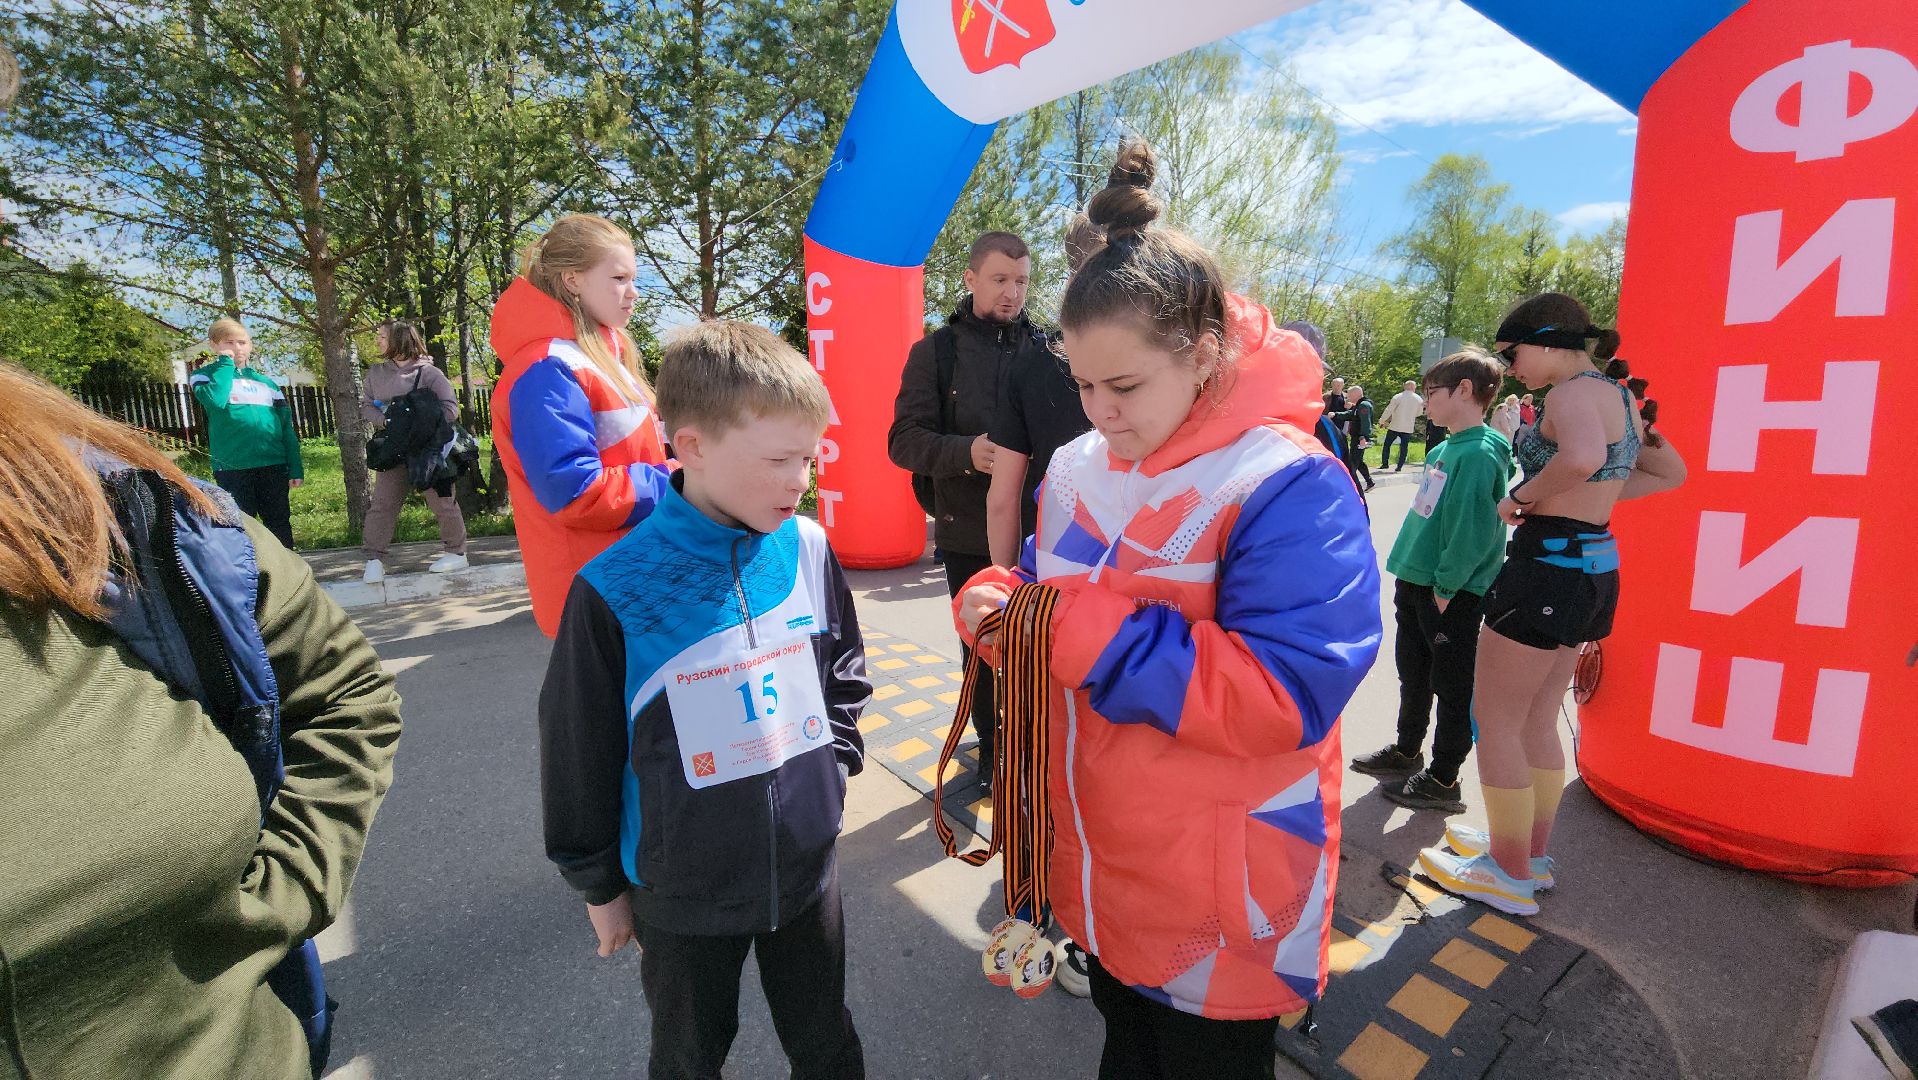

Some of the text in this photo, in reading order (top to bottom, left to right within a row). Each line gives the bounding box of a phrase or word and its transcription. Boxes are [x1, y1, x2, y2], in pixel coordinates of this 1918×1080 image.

[1649, 39, 1918, 777] ФИНИШ
[676, 641, 807, 685] Рузский городской округ
[735, 671, 778, 724] 15
